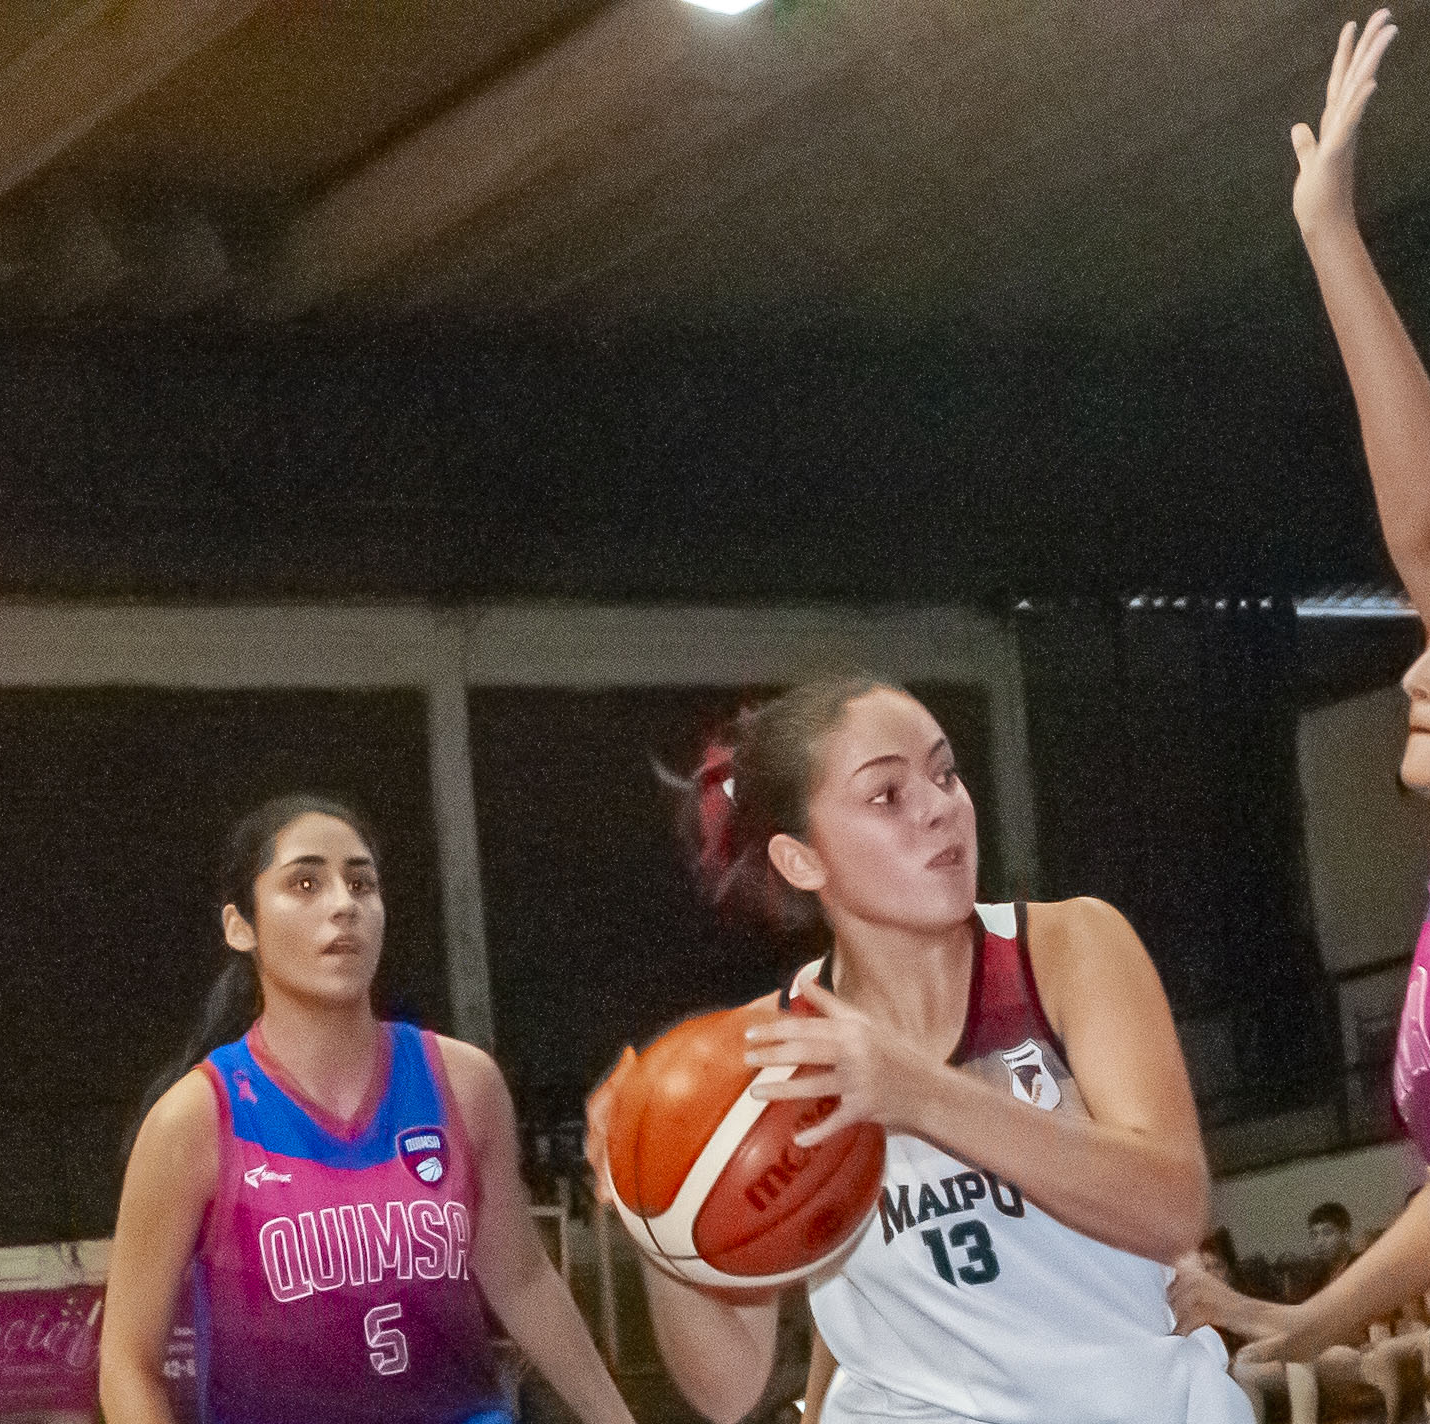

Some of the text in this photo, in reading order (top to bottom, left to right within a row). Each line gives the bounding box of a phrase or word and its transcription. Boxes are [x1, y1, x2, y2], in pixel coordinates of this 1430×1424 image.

[259, 1200, 470, 1302] QUIMSA
[921, 1218, 1001, 1288] 13
[364, 1303, 409, 1376] 5
